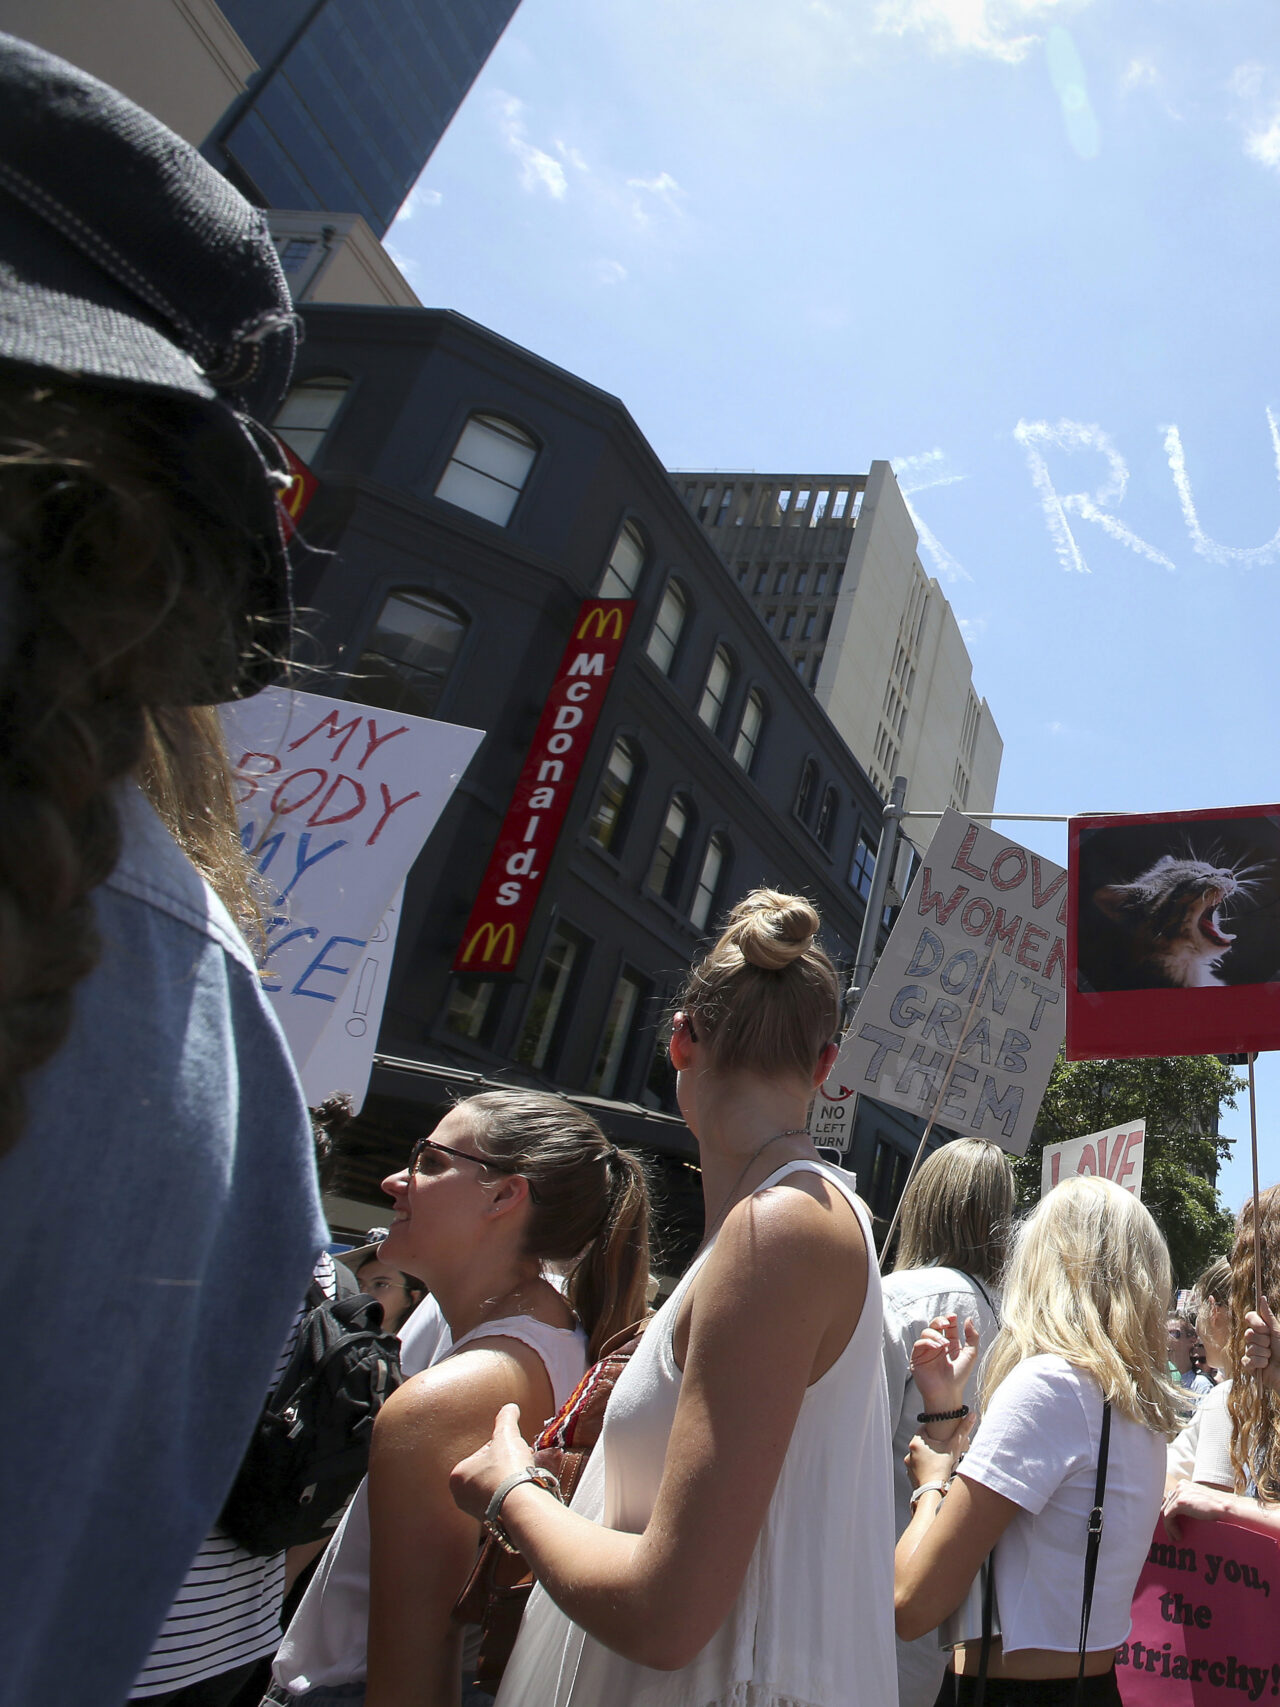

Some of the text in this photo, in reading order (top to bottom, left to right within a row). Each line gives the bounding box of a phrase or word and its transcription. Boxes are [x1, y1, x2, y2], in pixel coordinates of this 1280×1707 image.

[287, 709, 410, 770] MY
[233, 752, 422, 847] BODY
[495, 653, 605, 906] McDonald's
[952, 823, 1067, 924] LOV
[905, 927, 1061, 1032] DON'T
[890, 984, 1032, 1074] GRAB
[858, 1022, 1025, 1138] THEM
[812, 1136, 845, 1147] TURN
[815, 1123, 846, 1133] LEFT
[821, 1105, 845, 1120] NO
[1204, 1553, 1271, 1598] you,
[1158, 1591, 1212, 1629] the
[1115, 1640, 1280, 1701] atriarchy!
